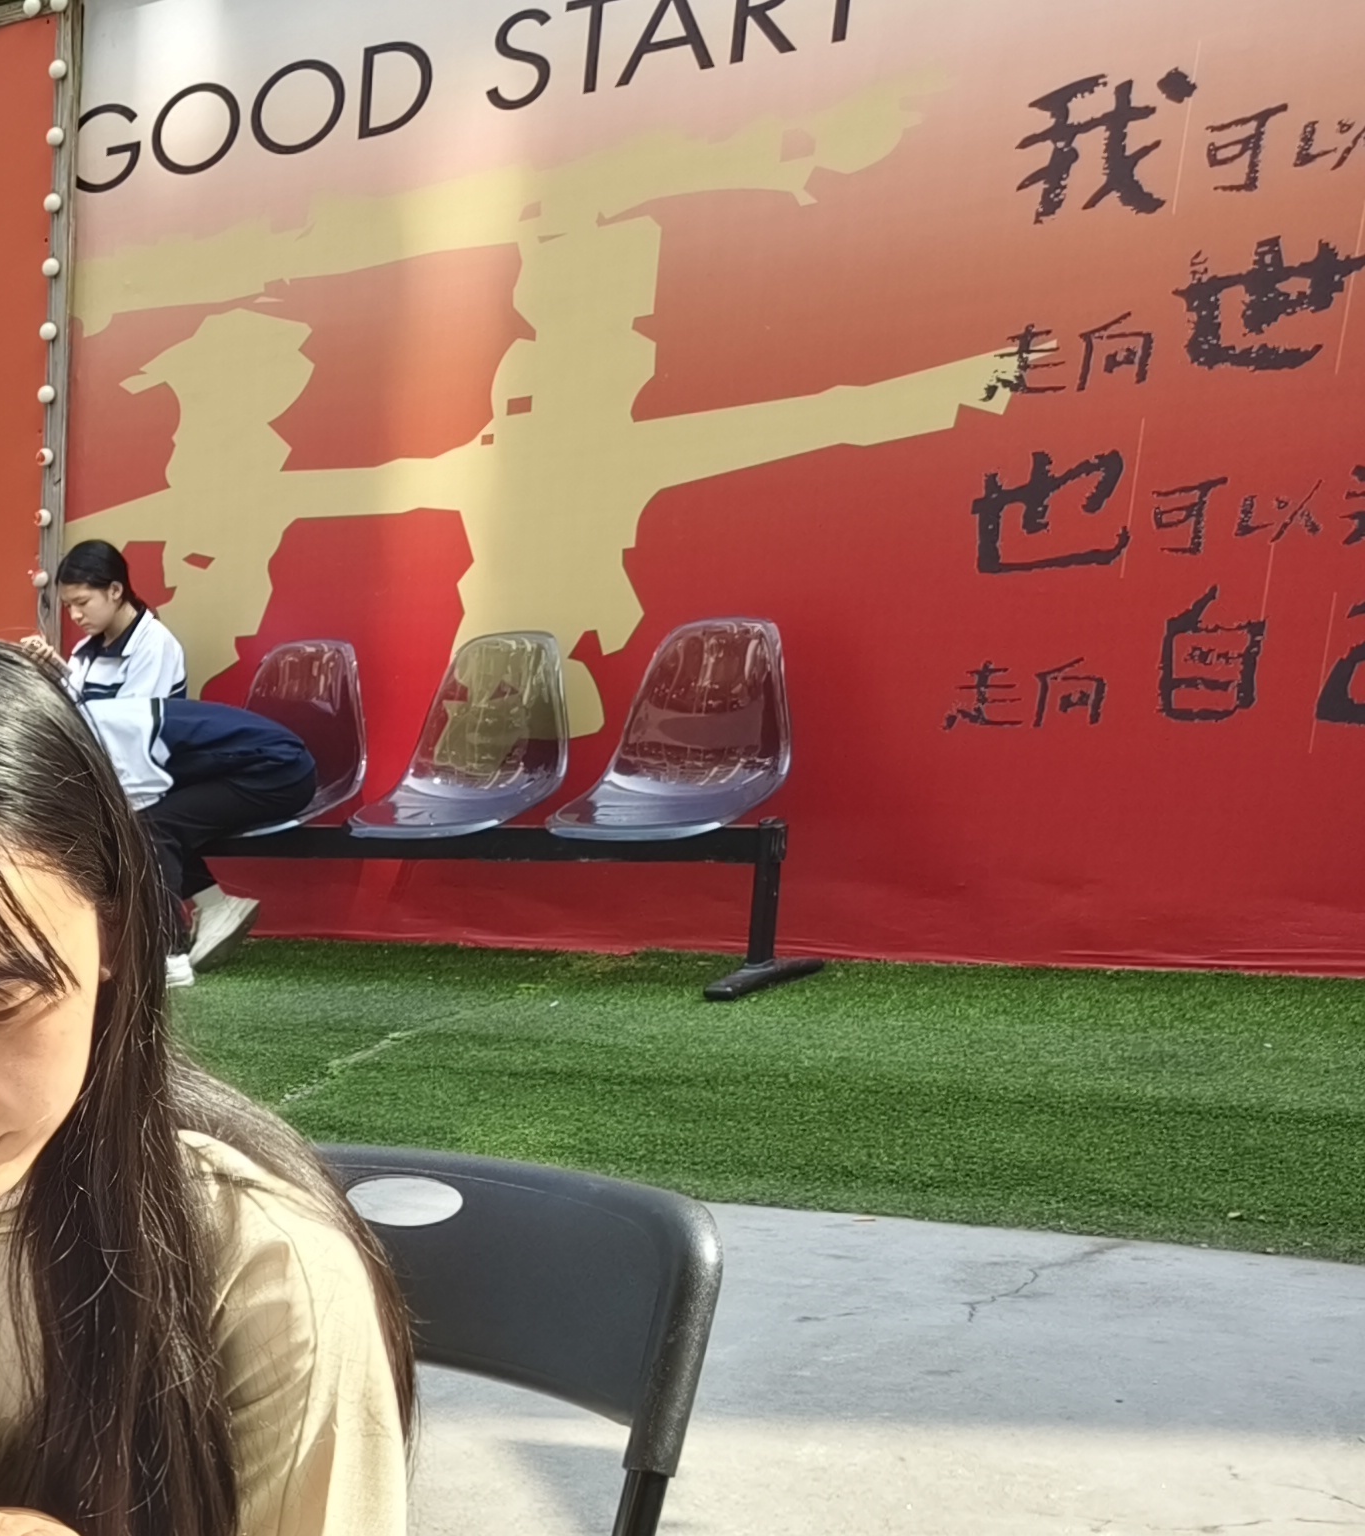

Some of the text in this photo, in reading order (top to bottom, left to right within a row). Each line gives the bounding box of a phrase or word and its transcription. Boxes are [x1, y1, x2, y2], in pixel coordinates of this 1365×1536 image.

[74, 41, 434, 194] GOOD
[1015, 66, 1365, 225] 我可以
